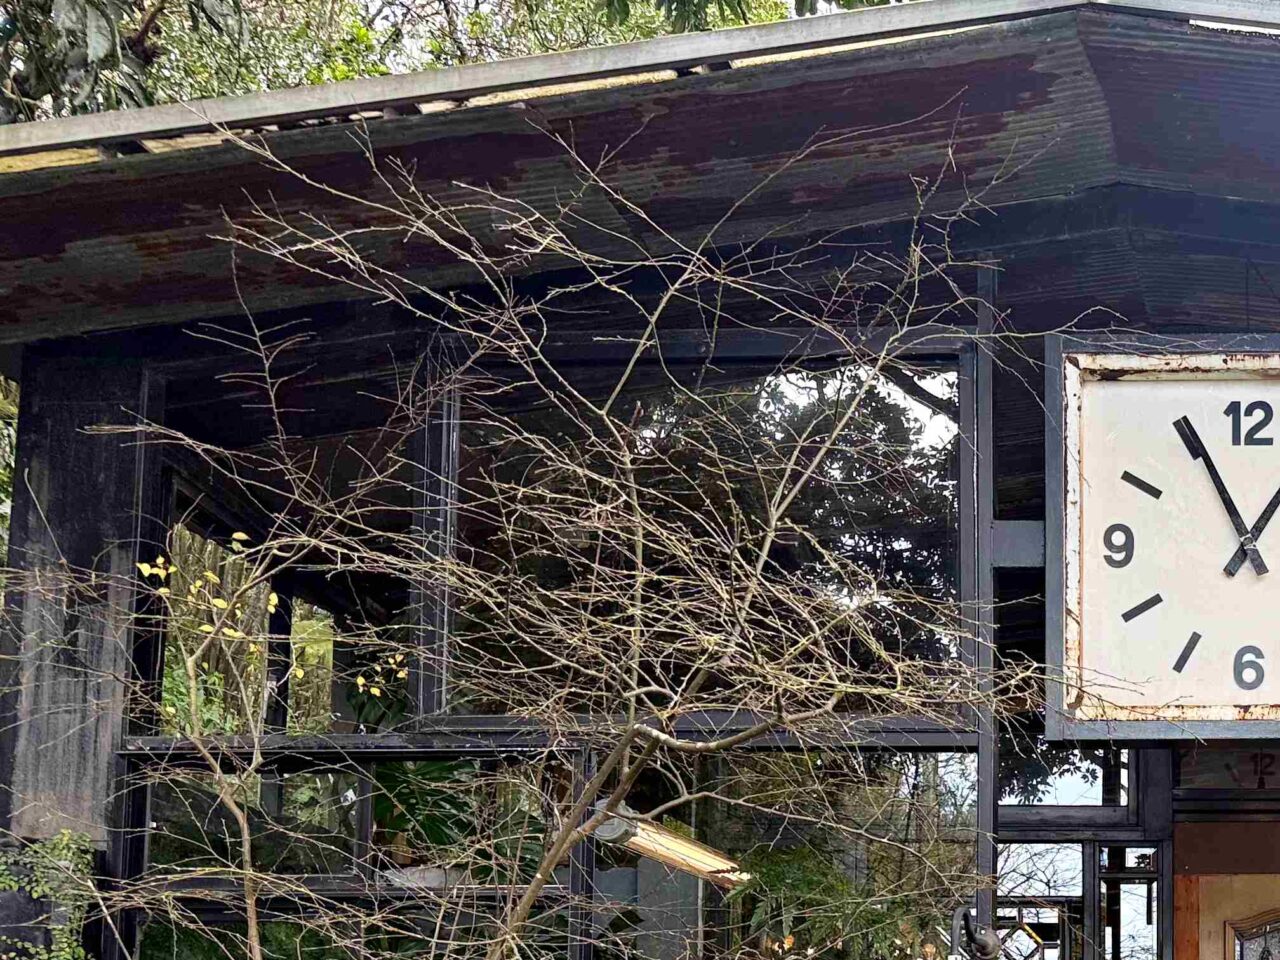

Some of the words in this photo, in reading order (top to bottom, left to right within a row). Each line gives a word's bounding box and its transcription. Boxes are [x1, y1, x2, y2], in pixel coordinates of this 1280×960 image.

[1223, 400, 1274, 446] 12
[1103, 523, 1135, 568] 9
[1233, 645, 1265, 691] 6
[1250, 752, 1275, 776] 12
